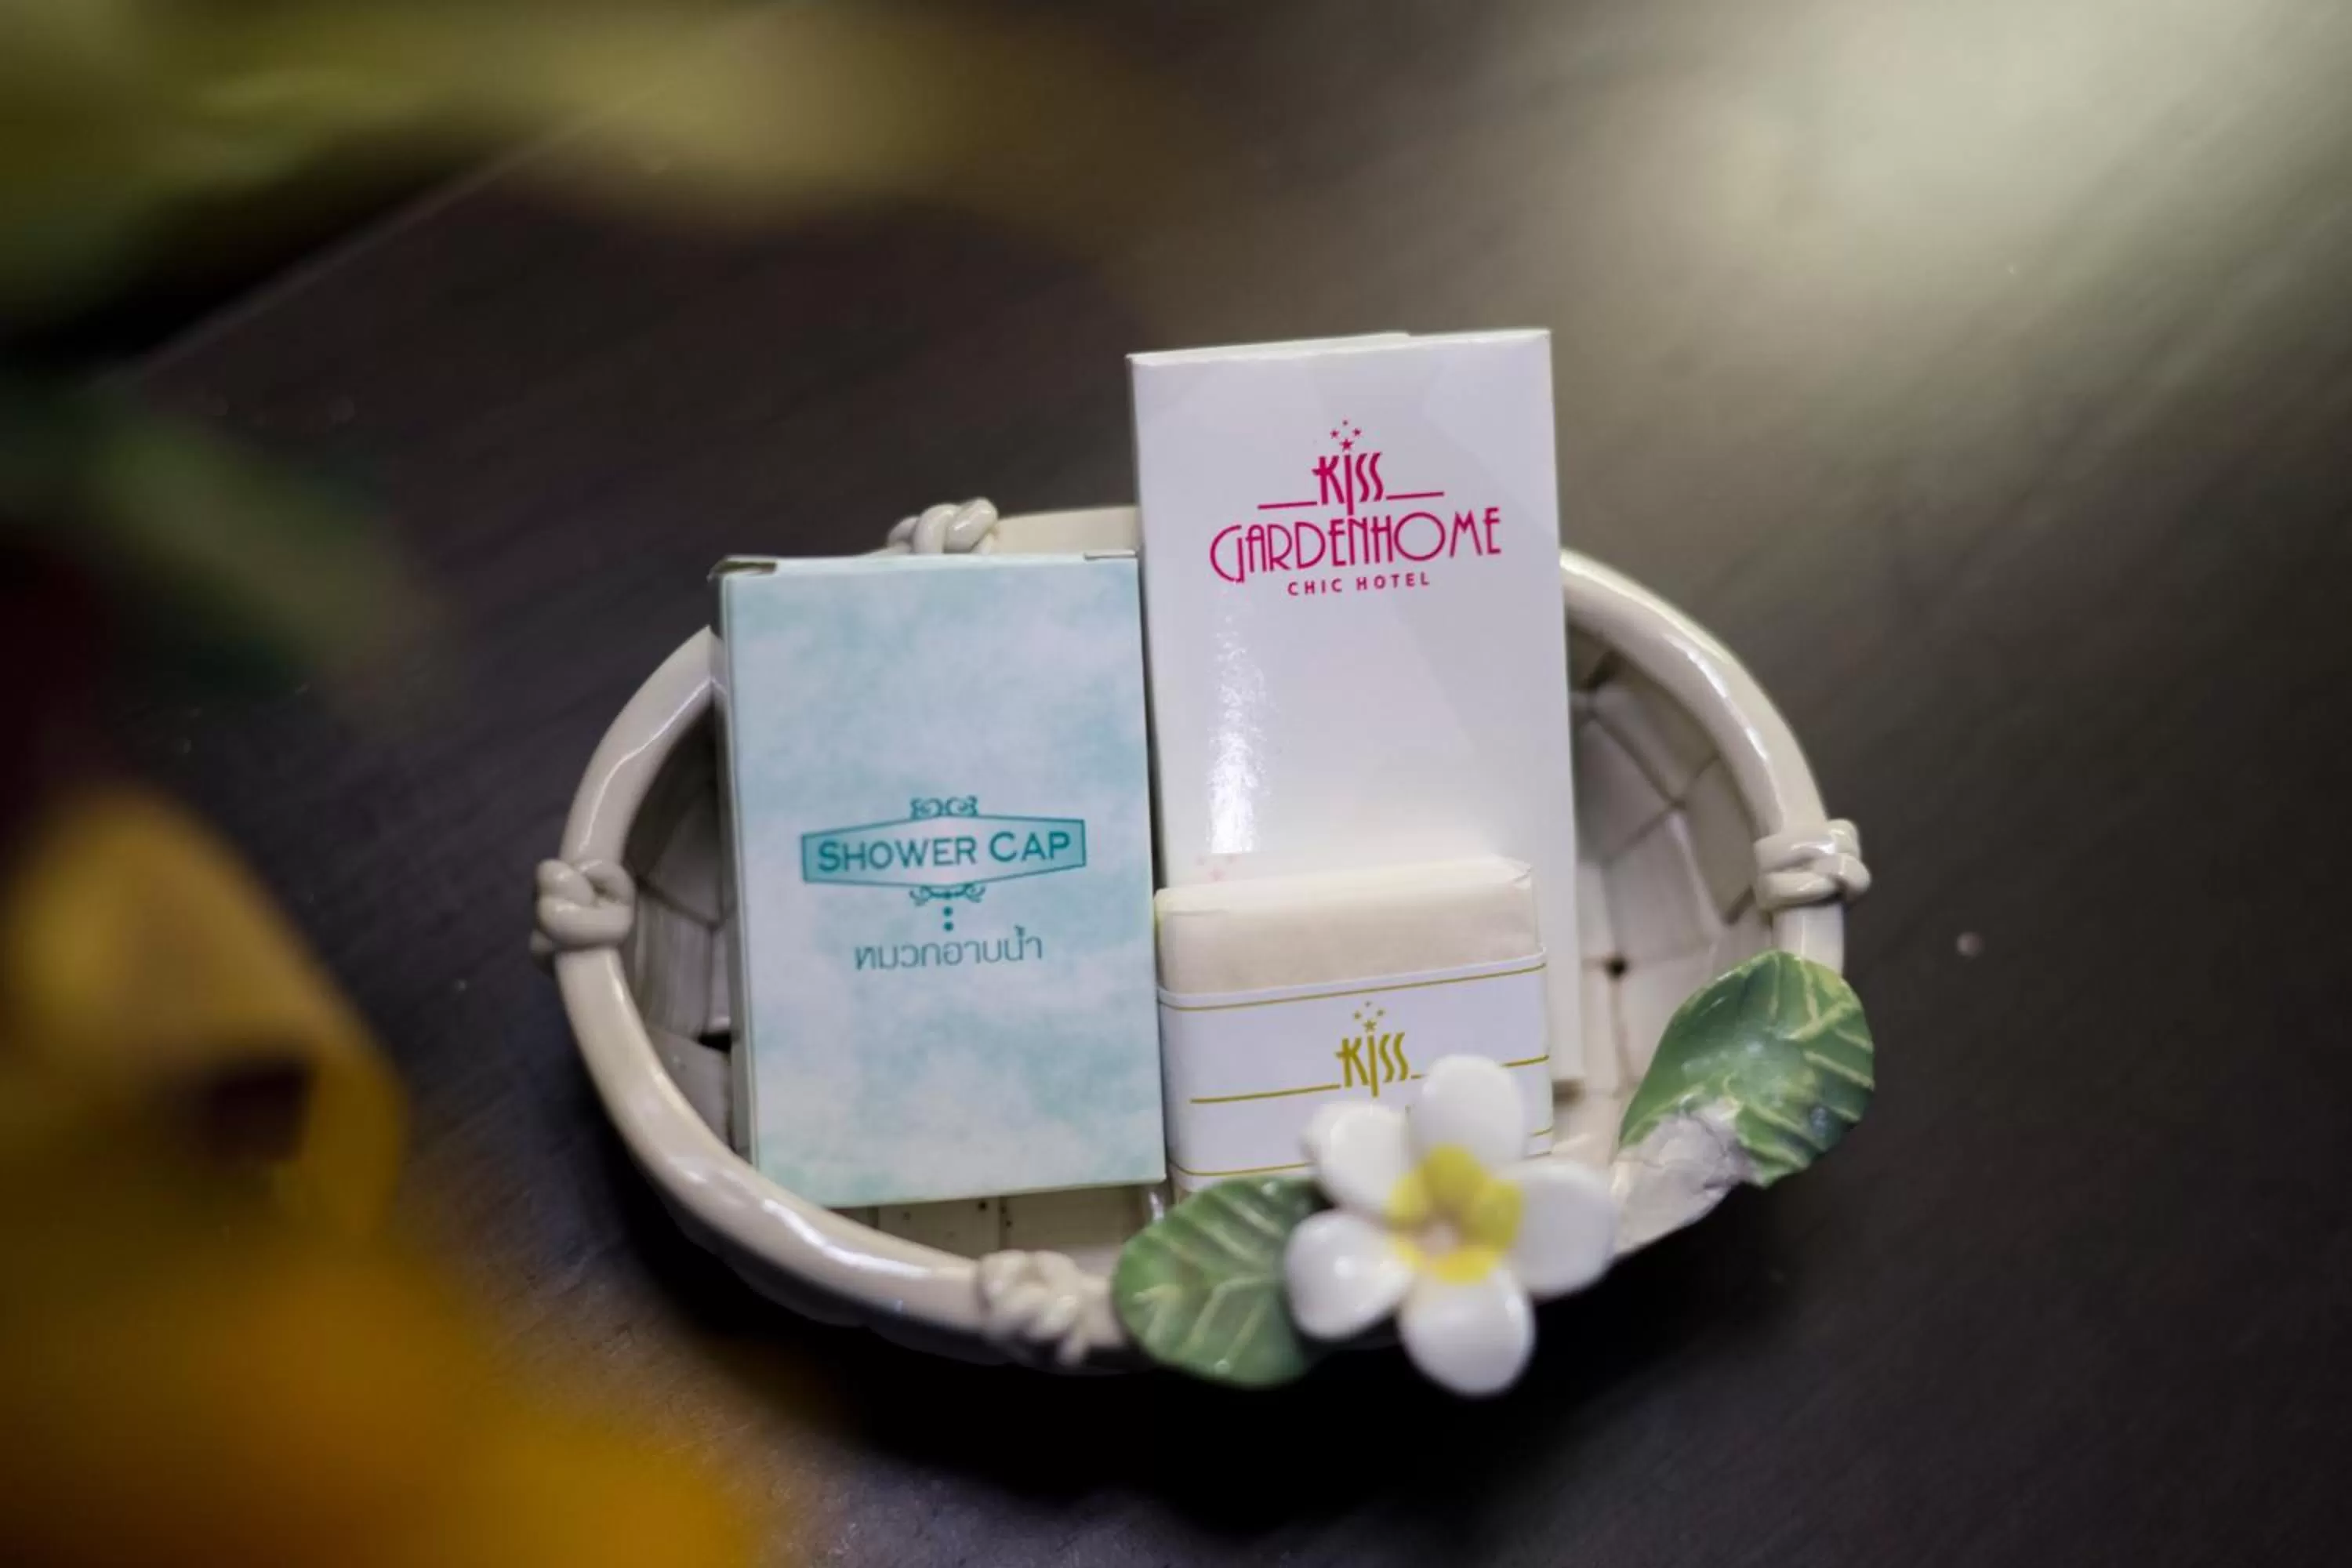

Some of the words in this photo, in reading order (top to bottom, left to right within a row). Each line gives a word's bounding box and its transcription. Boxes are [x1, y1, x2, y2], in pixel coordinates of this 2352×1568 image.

[1209, 506, 1502, 584] GARDENHOME
[1287, 578, 1342, 597] CHIC
[1356, 572, 1430, 591] HOTEL
[817, 836, 977, 873] SHOWER
[988, 830, 1071, 863] CAP
